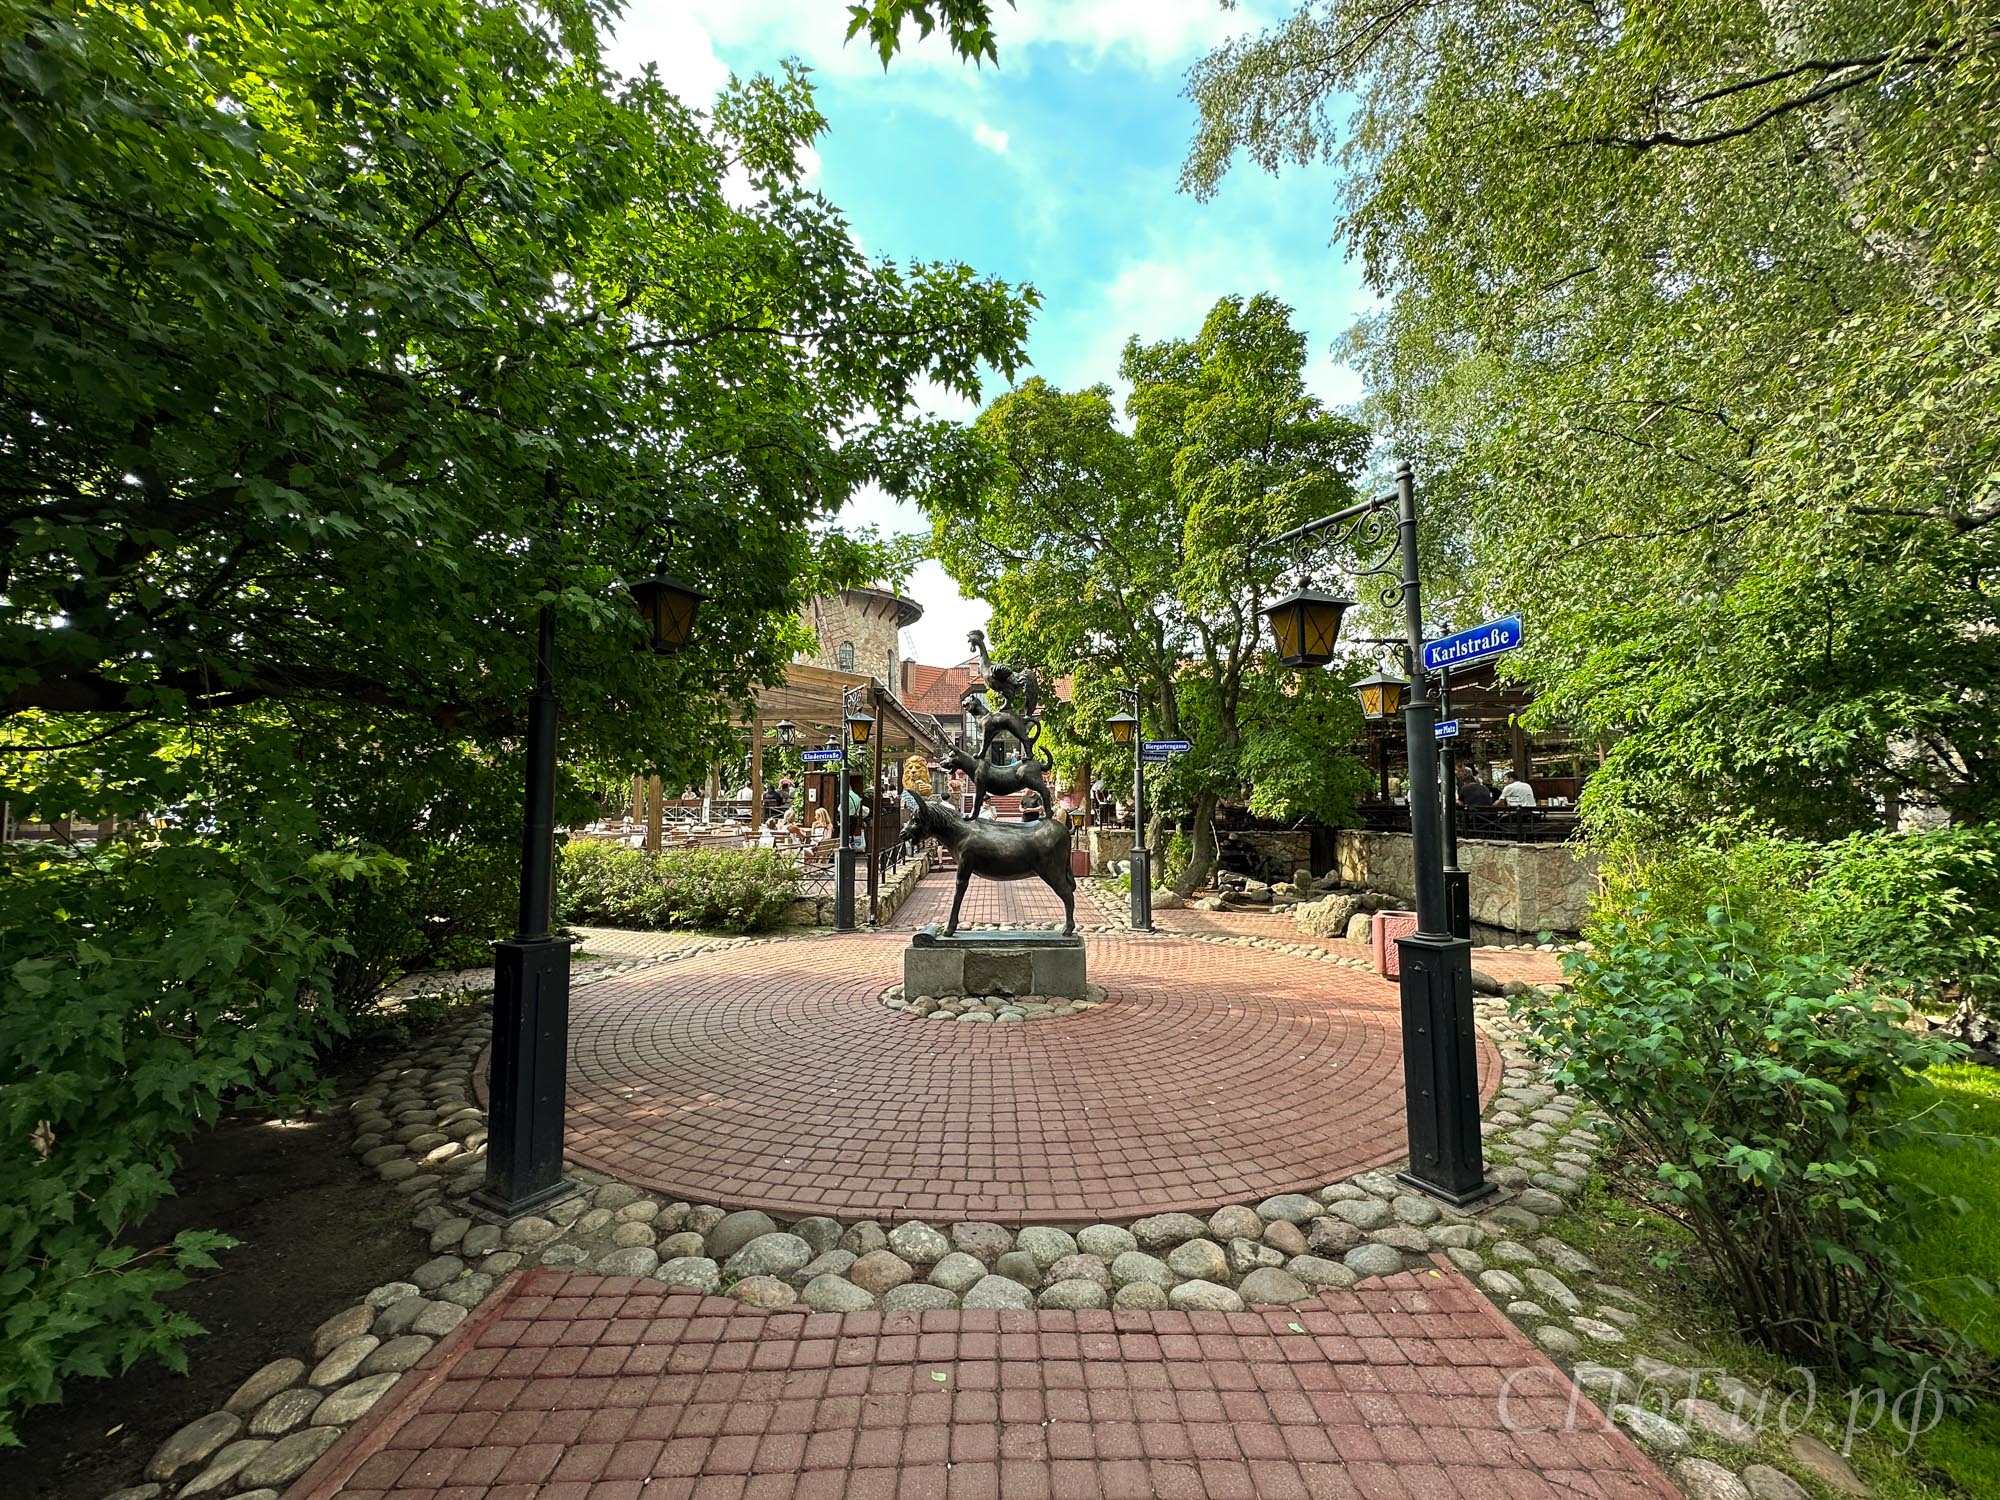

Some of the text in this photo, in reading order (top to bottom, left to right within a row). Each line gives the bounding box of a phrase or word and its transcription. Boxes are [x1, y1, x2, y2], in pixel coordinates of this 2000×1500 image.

[1431, 628, 1510, 664] Karlstraße
[1443, 726, 1456, 734] Platz
[803, 752, 839, 760] Kinderstraße
